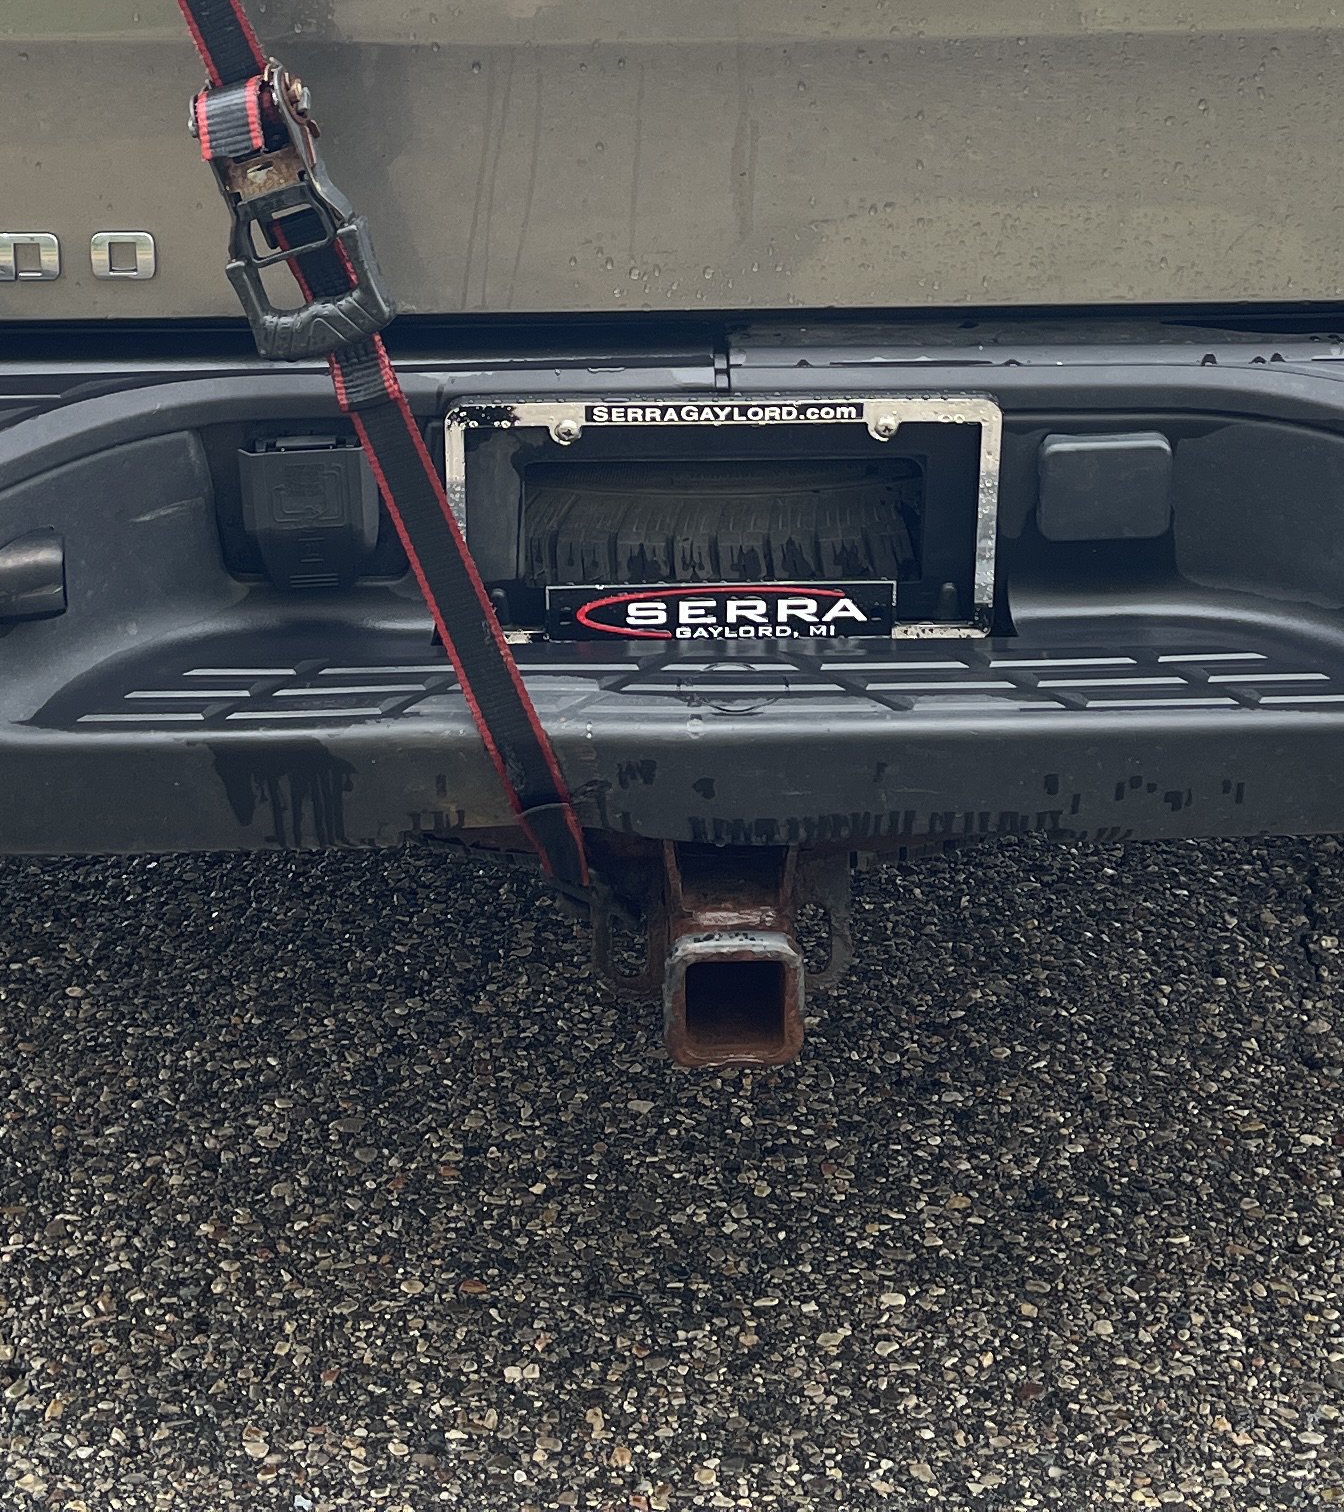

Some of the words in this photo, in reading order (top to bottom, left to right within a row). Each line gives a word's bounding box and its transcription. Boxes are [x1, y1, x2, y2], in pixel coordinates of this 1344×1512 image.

[592, 405, 857, 423] SERRAGAYLORD.com
[625, 598, 868, 625] SERRA
[675, 625, 800, 638] GAYLORD,
[809, 624, 836, 637] MI
